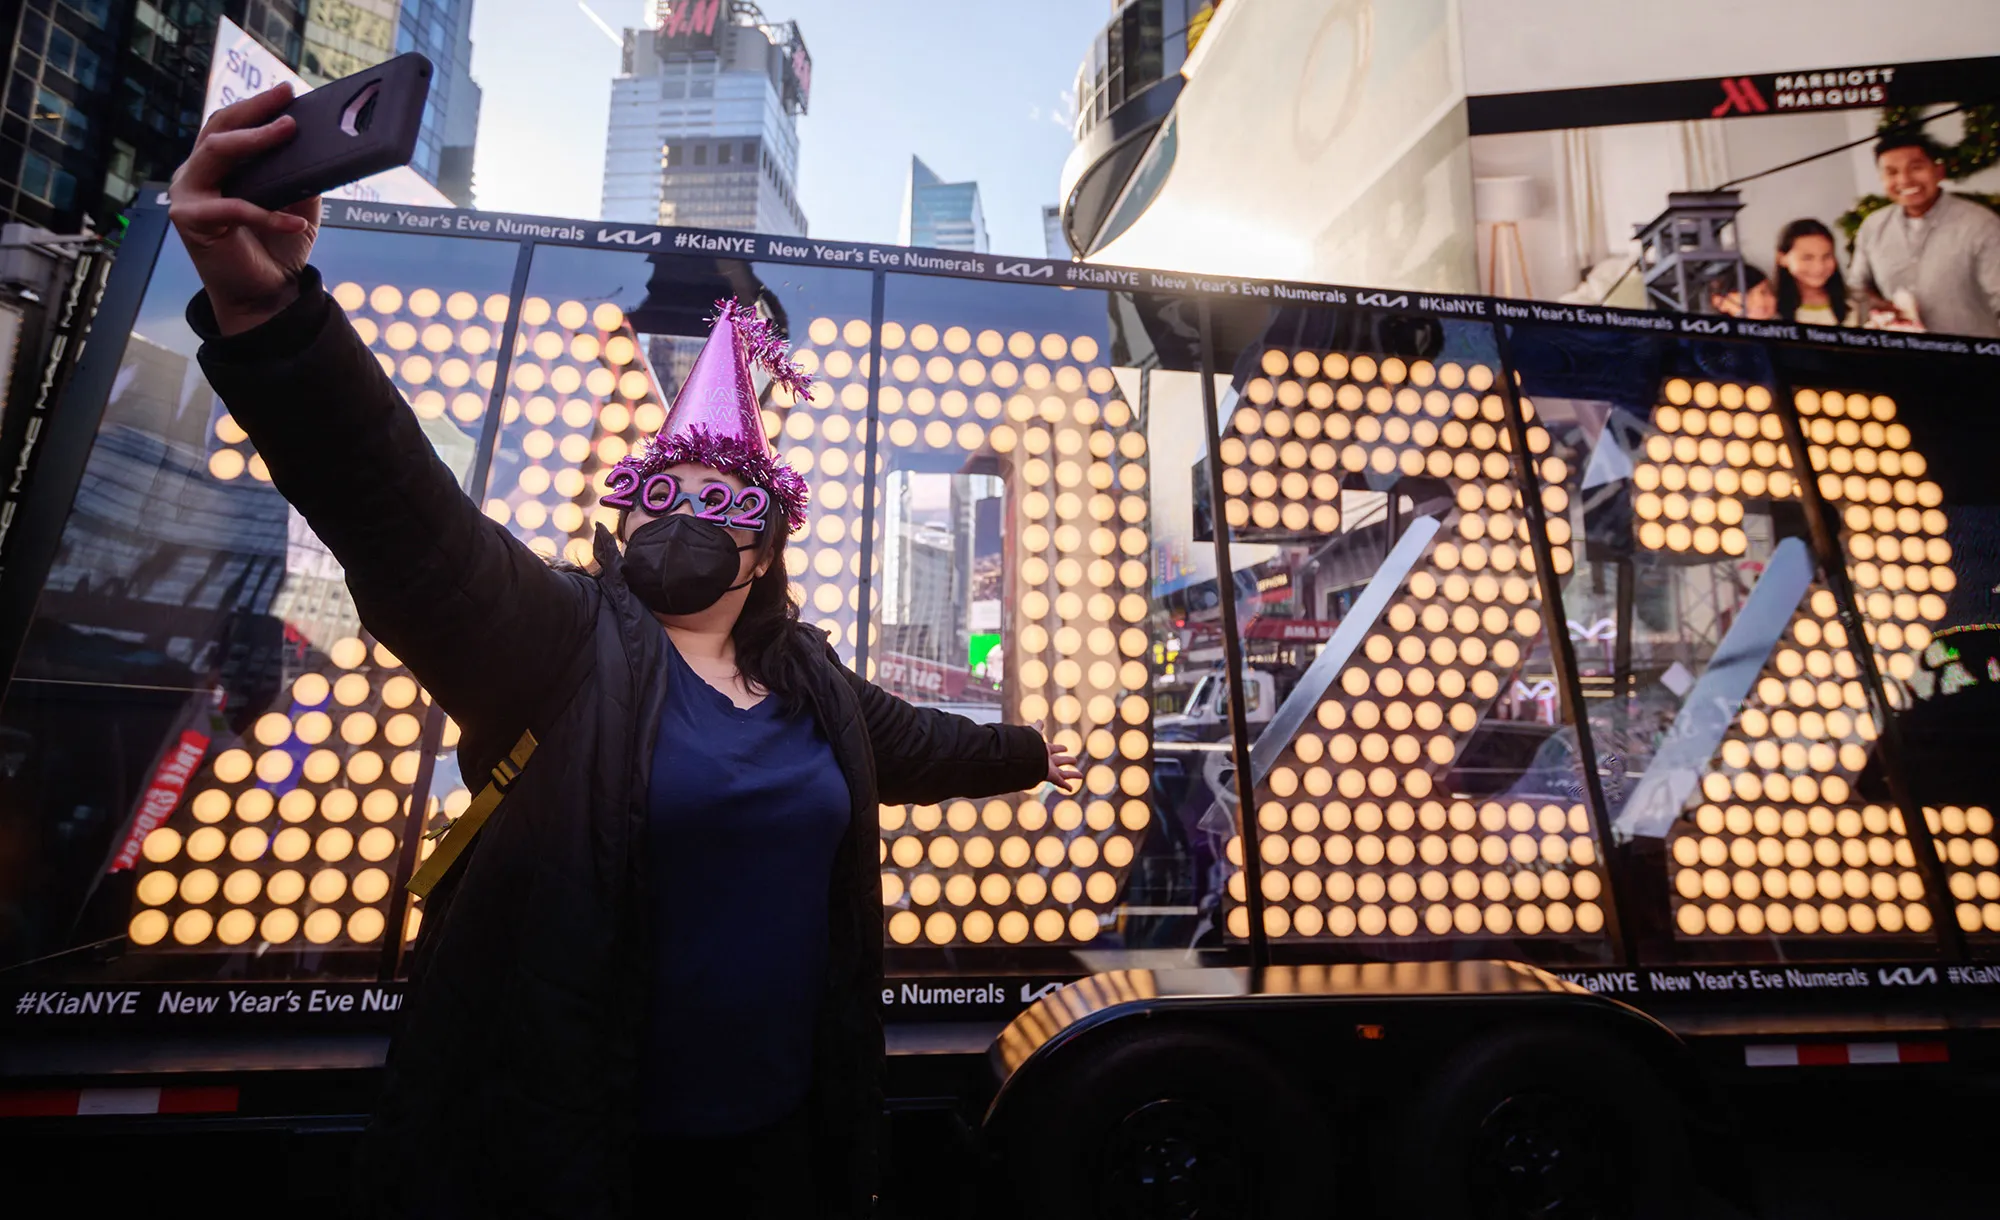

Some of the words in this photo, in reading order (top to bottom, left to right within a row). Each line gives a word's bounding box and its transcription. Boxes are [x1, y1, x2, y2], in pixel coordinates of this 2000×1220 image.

[226, 48, 262, 90] sip
[1775, 67, 1895, 91] MARRIOTT
[1777, 87, 1885, 108] MARQUIS
[345, 206, 390, 224] New
[396, 210, 451, 229] Year's
[457, 215, 490, 232] Eve
[495, 218, 585, 241] Numerals
[674, 233, 755, 253] #KiaNYE
[768, 241, 808, 258] New
[813, 245, 864, 263] Year's
[868, 249, 899, 265] Eve
[904, 252, 985, 273] Numerals
[1066, 266, 1139, 286] #KiaNYE
[1152, 274, 1187, 289] New
[1192, 277, 1238, 294] Year's
[1242, 282, 1270, 297] Eve
[1274, 284, 1347, 304] Numerals
[1418, 297, 1486, 315] #KiaNYE
[1495, 302, 1529, 318] New
[1531, 305, 1574, 322] Year's
[1576, 309, 1603, 323] Eve
[1606, 312, 1674, 331] Numerals
[1737, 322, 1800, 340] #KiaNYE
[1806, 328, 1837, 343] New
[1839, 331, 1878, 347] Year's
[1880, 334, 1905, 349] Eve
[1907, 337, 1969, 353] Numerals
[16, 991, 141, 1014] #KiaNYE
[158, 991, 220, 1013] New
[228, 989, 301, 1013] Year's
[307, 989, 354, 1012] Eve
[901, 983, 1005, 1004] Numerals
[1649, 971, 1691, 992] New
[1693, 970, 1748, 990] Year's
[1749, 969, 1783, 989] Eve
[1786, 968, 1870, 988] Numerals
